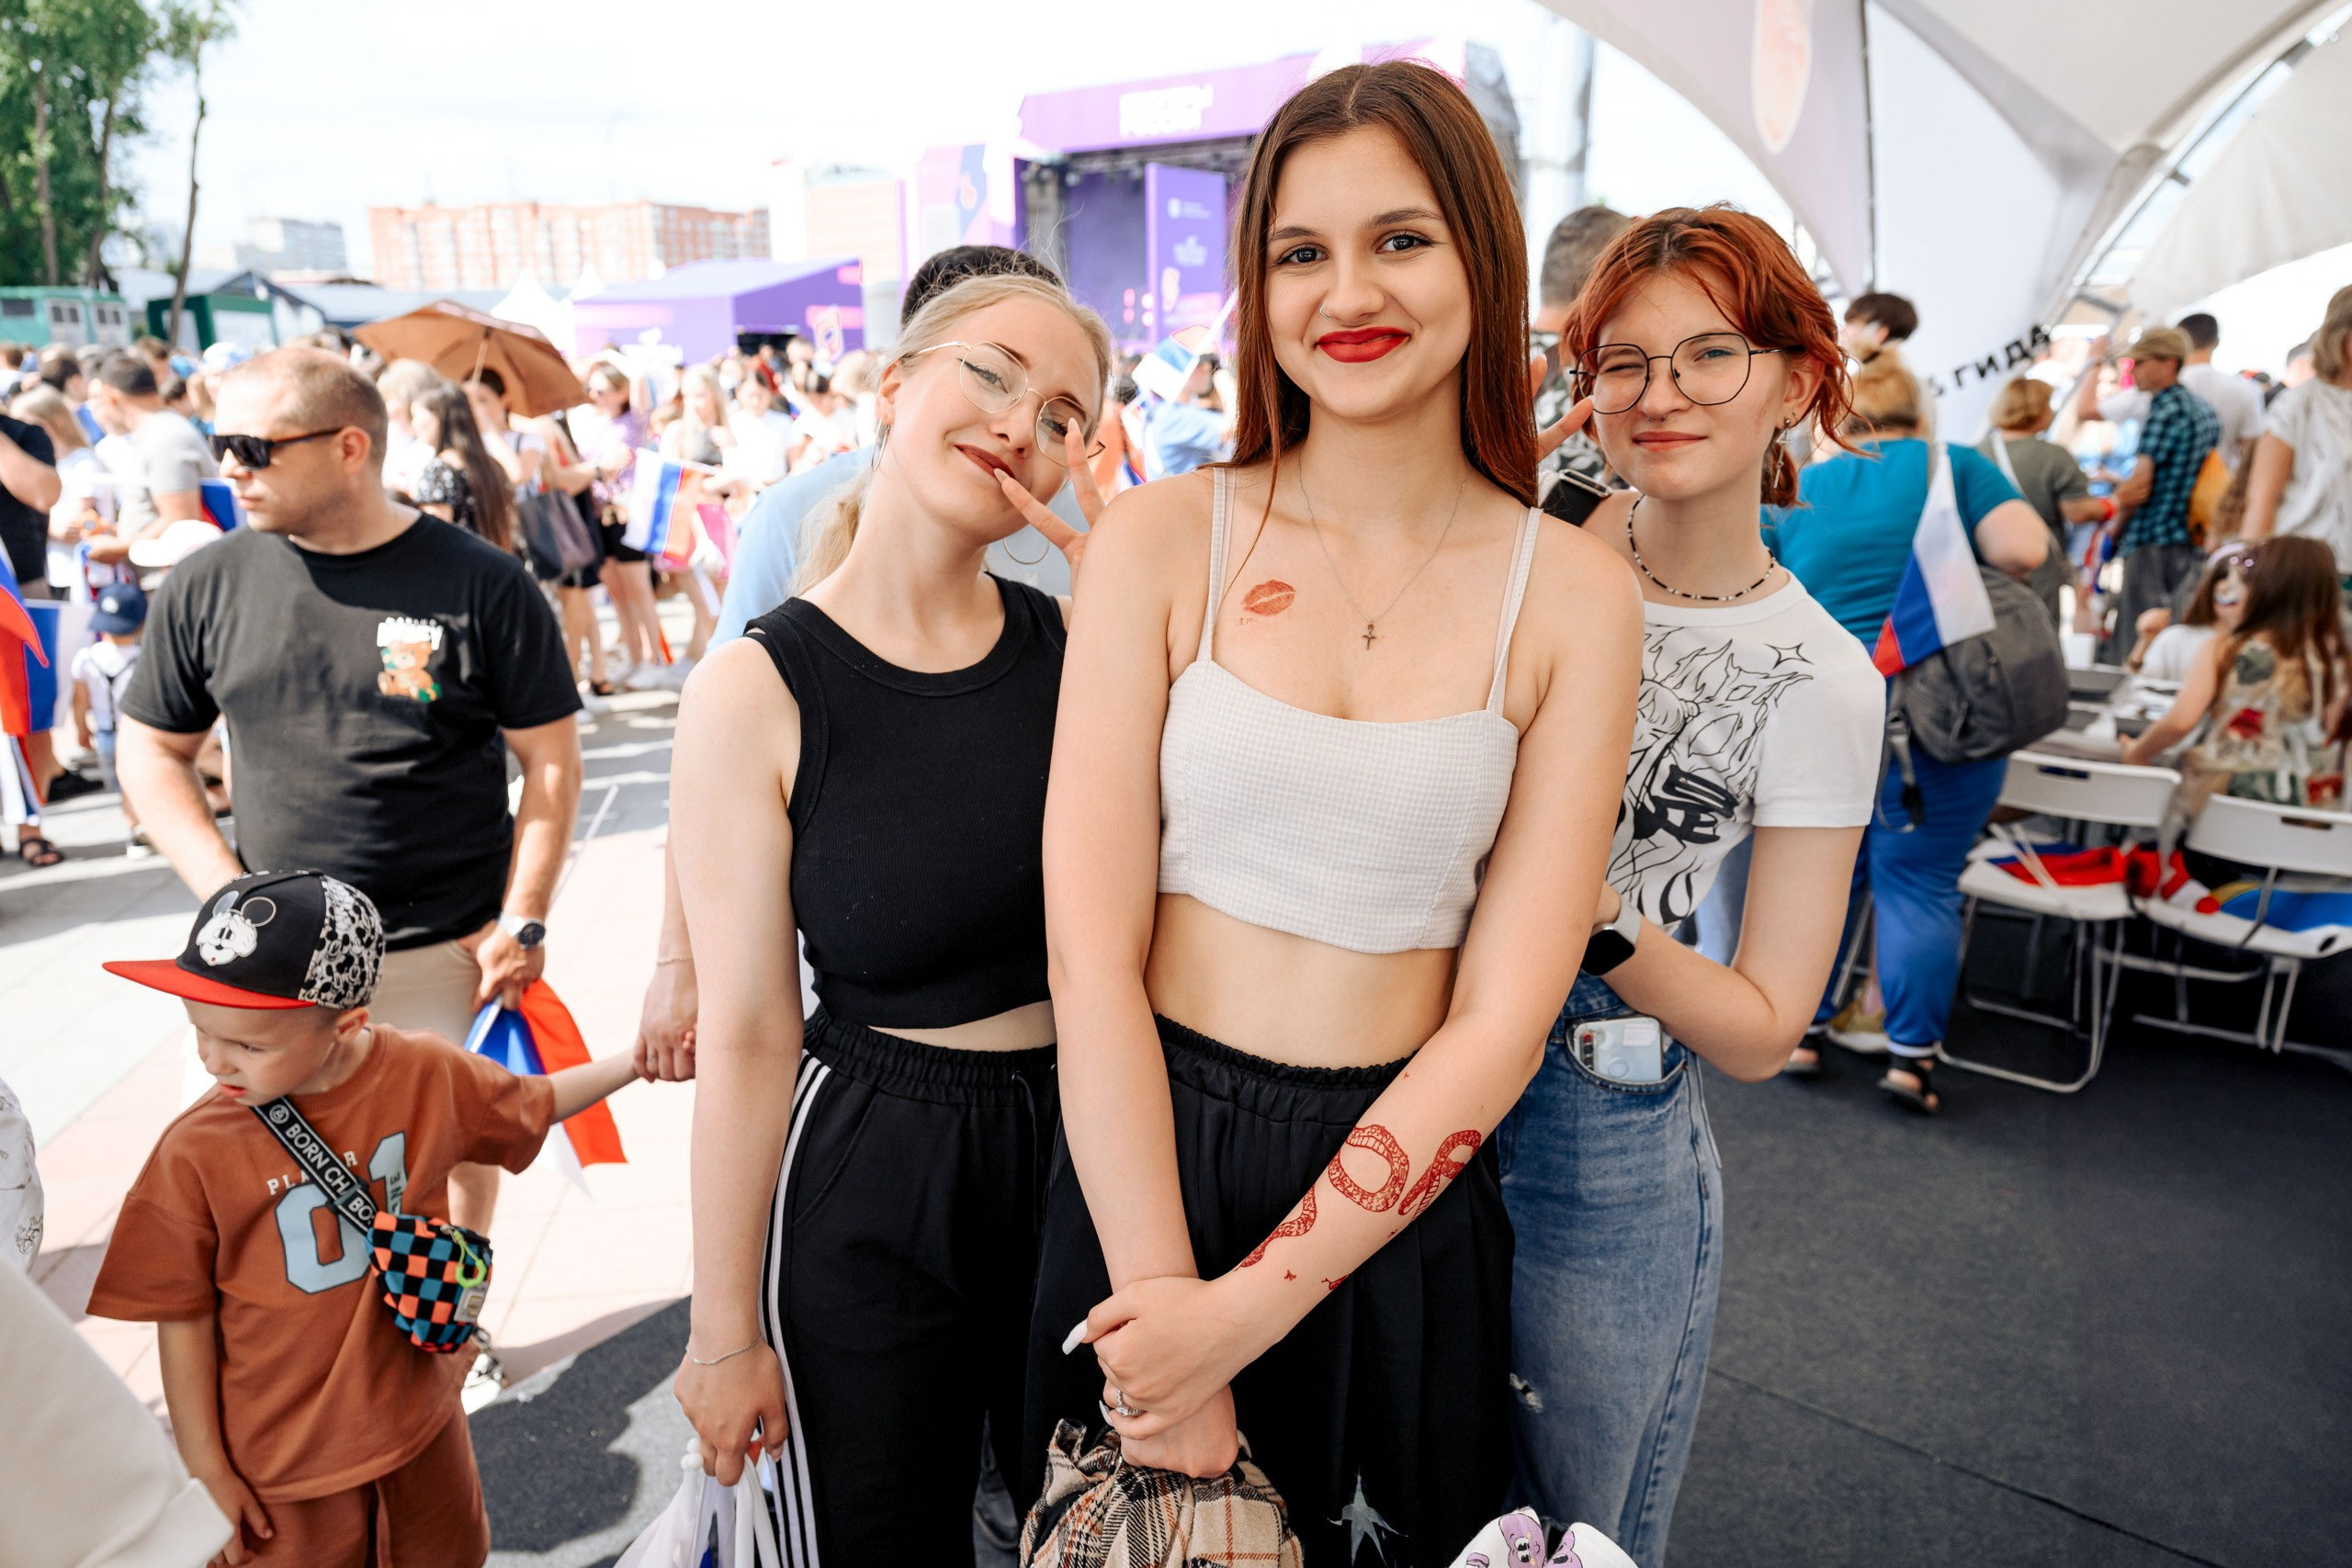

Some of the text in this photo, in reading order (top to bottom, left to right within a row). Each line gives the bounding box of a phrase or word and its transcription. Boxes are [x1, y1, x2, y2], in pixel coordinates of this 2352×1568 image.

[285, 1122, 330, 1169] BORN
[266, 1150, 358, 1195] PLAR
[347, 1197, 375, 1225] BO
